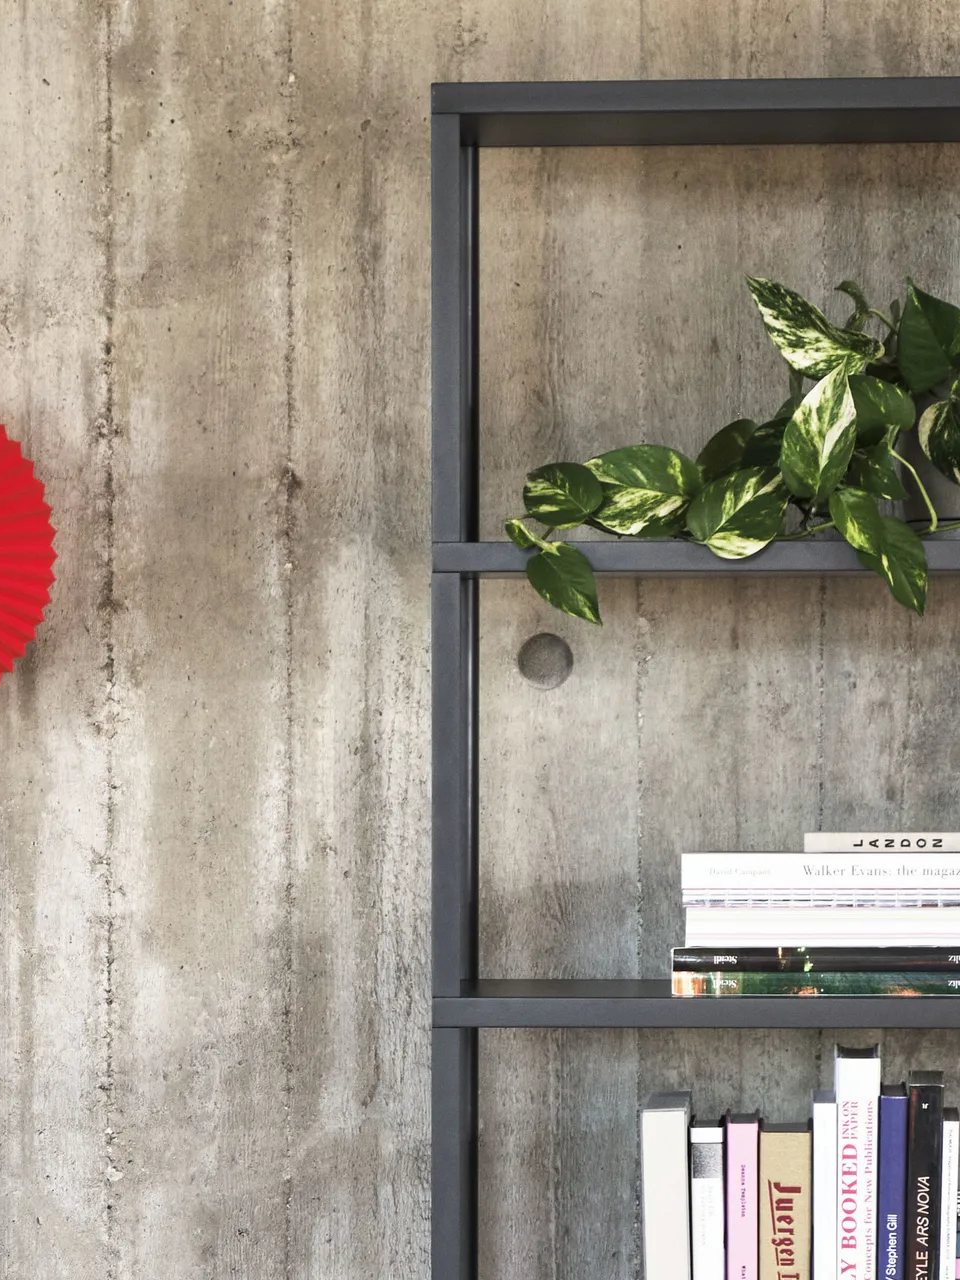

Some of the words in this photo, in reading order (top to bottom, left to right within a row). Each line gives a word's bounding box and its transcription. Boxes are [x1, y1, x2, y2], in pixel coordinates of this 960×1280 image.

[853, 838, 943, 849] LANDON
[803, 864, 846, 877] Walker
[851, 864, 892, 877] Evans:
[897, 864, 918, 877] the
[713, 955, 738, 965] Steidl
[711, 979, 737, 989] Steidl
[842, 1101, 850, 1117] ON
[850, 1101, 858, 1140] PAPER
[842, 1120, 850, 1140] INK
[864, 1100, 873, 1174] Publications
[841, 1143, 858, 1250] BOOKED
[864, 1179, 872, 1203] New
[917, 1176, 930, 1215] NOVA
[771, 1181, 802, 1267] Juergen
[863, 1207, 873, 1224] for
[886, 1214, 898, 1231] Gill
[916, 1216, 929, 1247] ARS
[864, 1227, 874, 1280] Concepts
[885, 1232, 899, 1276] Stephen
